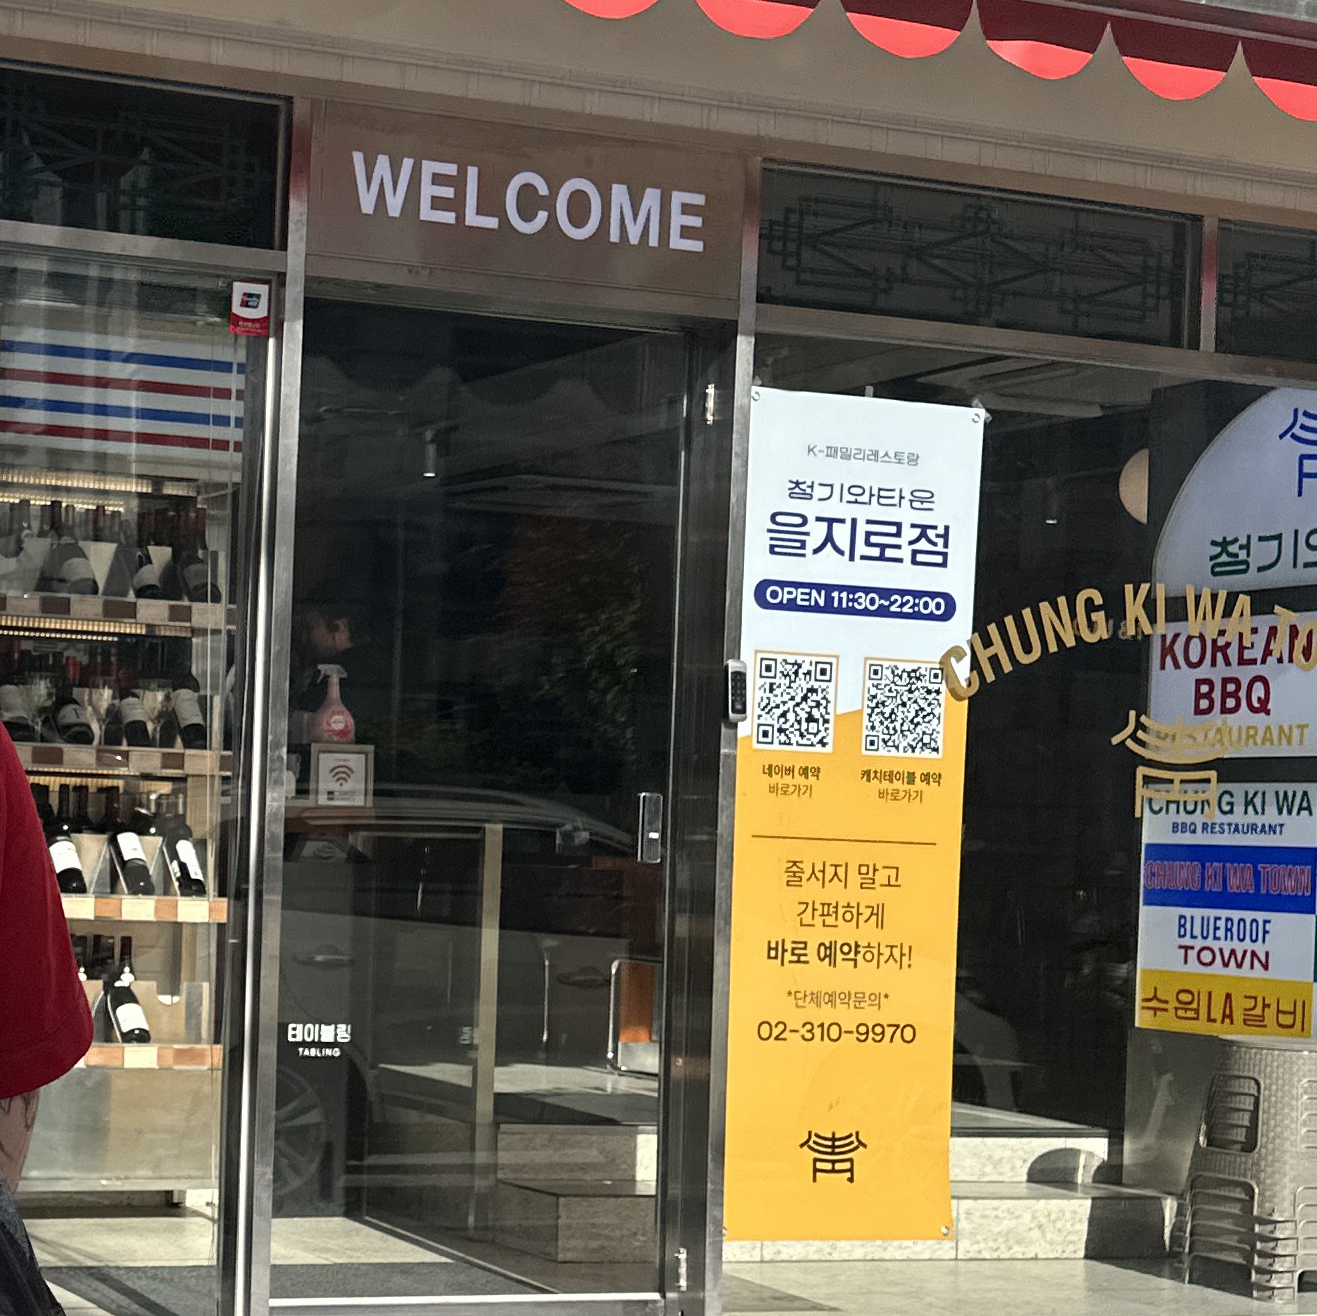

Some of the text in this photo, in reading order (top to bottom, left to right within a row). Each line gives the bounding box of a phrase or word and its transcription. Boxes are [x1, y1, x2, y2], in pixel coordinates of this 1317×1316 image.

[352, 150, 706, 252] WELCOME
[807, 444, 920, 467] K-패밀리레스토랑
[787, 479, 935, 512] 청기와타운
[766, 510, 950, 569] 을지로점
[765, 585, 945, 616] OPEN 11:30~22:00
[938, 587, 1109, 702] CHUNG
[1124, 582, 1166, 636] KI
[1185, 584, 1252, 648] WA
[1159, 623, 1314, 671] KOREAN
[1193, 674, 1271, 717] BBQ
[762, 764, 821, 780] 네이버 예약
[919, 772, 943, 787] 예약
[768, 782, 813, 798] 바로가기
[877, 788, 924, 804] 바로가기
[1243, 790, 1266, 815] KI
[1274, 790, 1313, 816] WA
[1172, 822, 1285, 836] BBQ RESTAURANT
[784, 860, 902, 891] 줄서지 말고
[796, 900, 885, 930] 간편하게
[1177, 914, 1272, 944] BLUEROOF
[766, 938, 913, 970] 바로 예약하자!
[1178, 944, 1270, 972] TOWN
[1141, 986, 1306, 1032] 수원LA갈비
[287, 1023, 352, 1043] 테이블링
[757, 1020, 916, 1044] 02-310-9970
